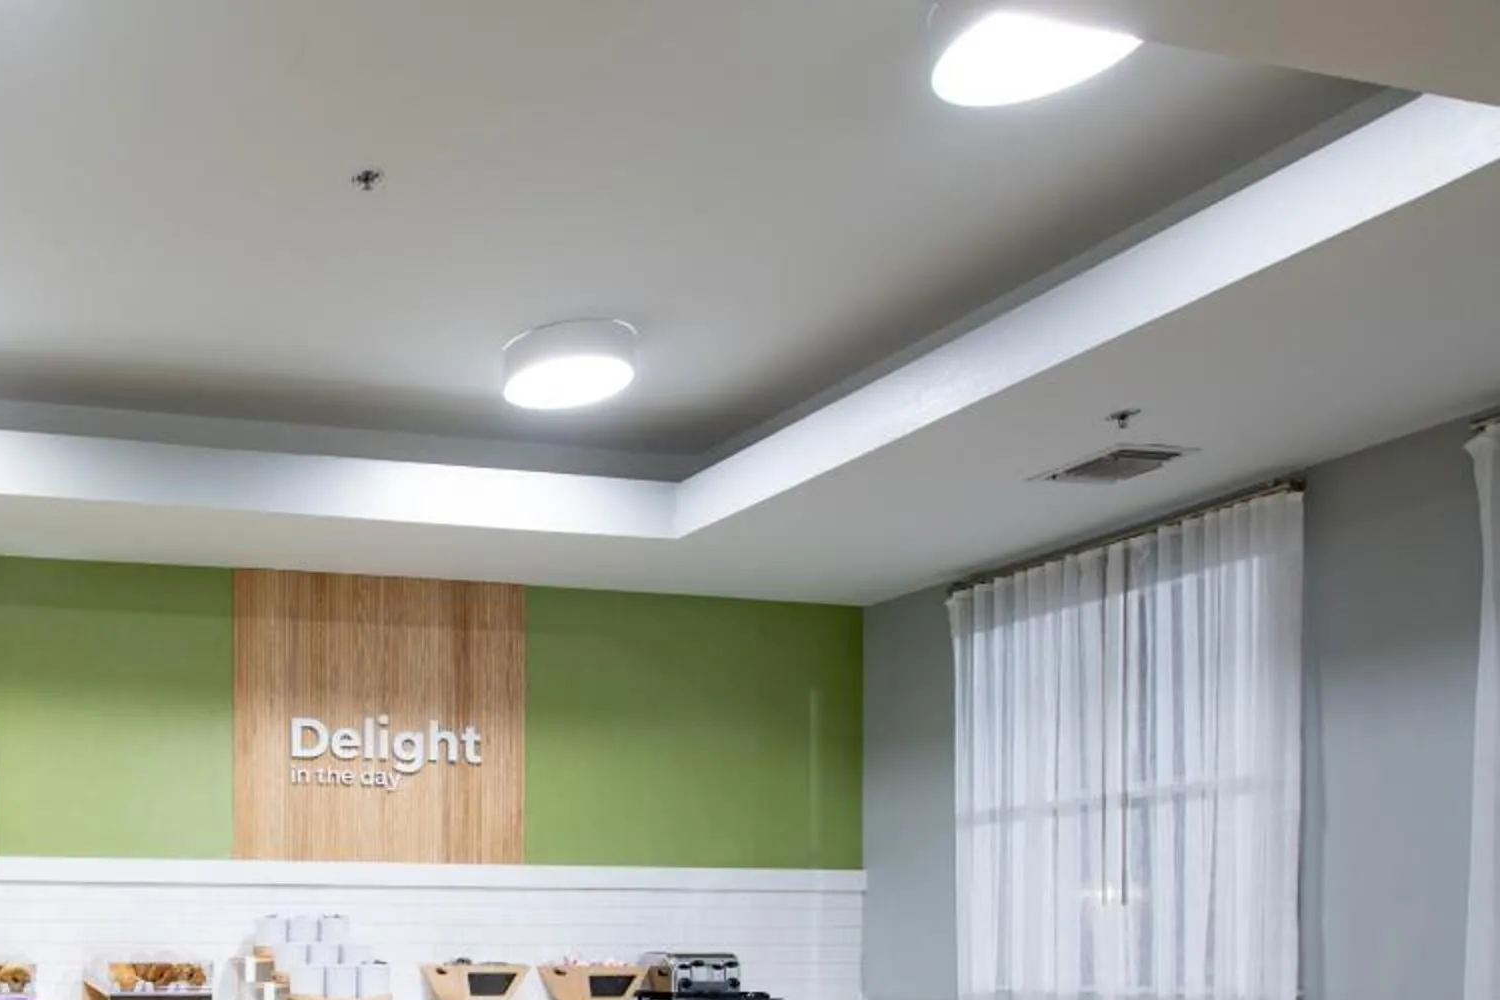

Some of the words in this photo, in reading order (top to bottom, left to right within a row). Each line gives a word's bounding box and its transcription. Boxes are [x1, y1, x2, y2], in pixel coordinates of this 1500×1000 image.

[291, 714, 483, 774] Delight
[291, 765, 310, 785] in
[315, 767, 354, 787] the
[359, 765, 402, 793] day
